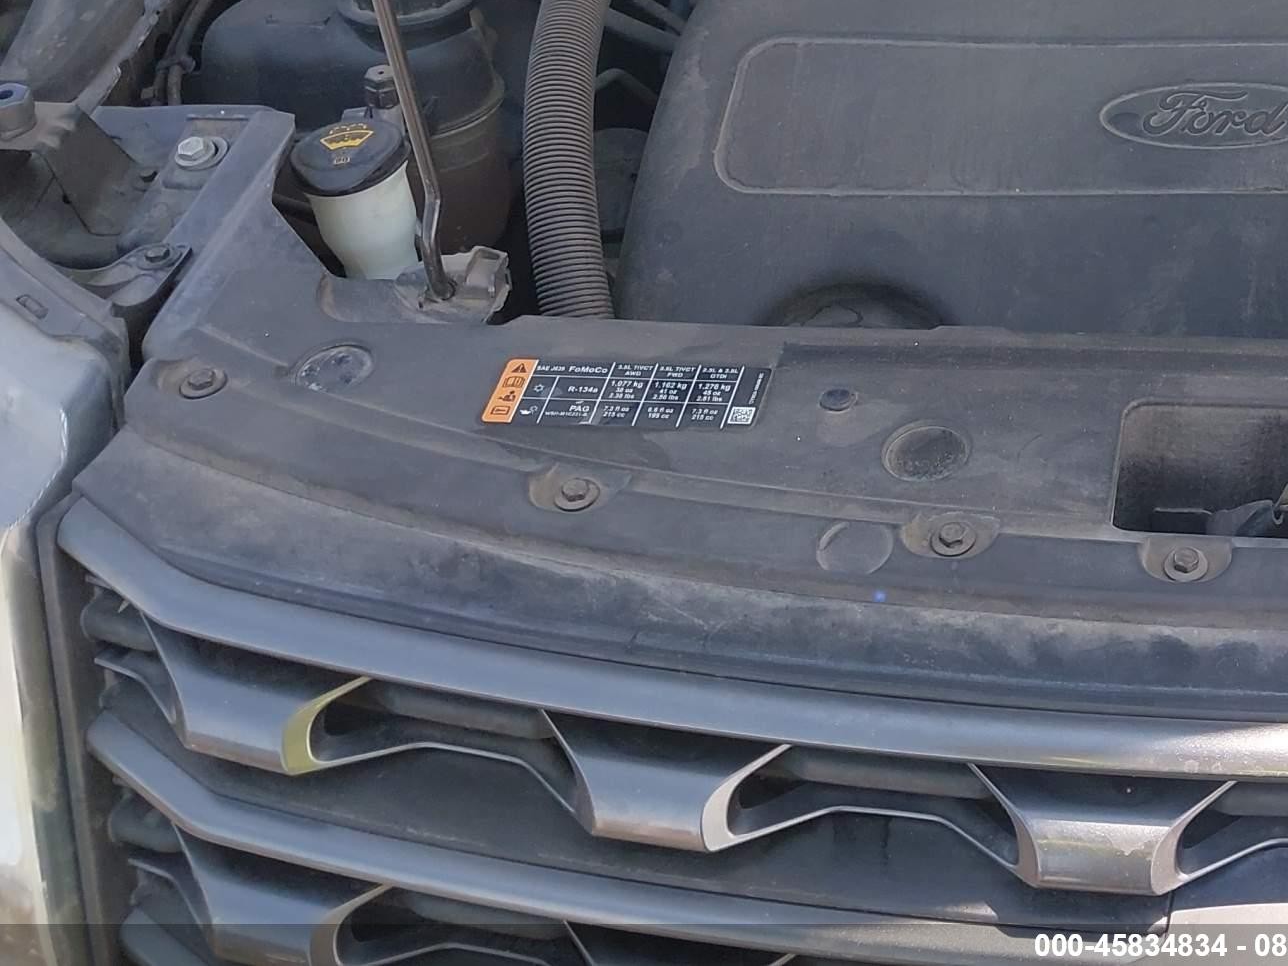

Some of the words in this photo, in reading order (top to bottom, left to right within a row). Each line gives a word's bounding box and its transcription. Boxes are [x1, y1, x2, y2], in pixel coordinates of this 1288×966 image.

[568, 365, 608, 374] FoMoCo
[633, 380, 644, 389] kg
[654, 381, 676, 389] 1.162
[677, 382, 687, 390] kg
[720, 384, 731, 392] kg
[567, 385, 598, 394] R-134a
